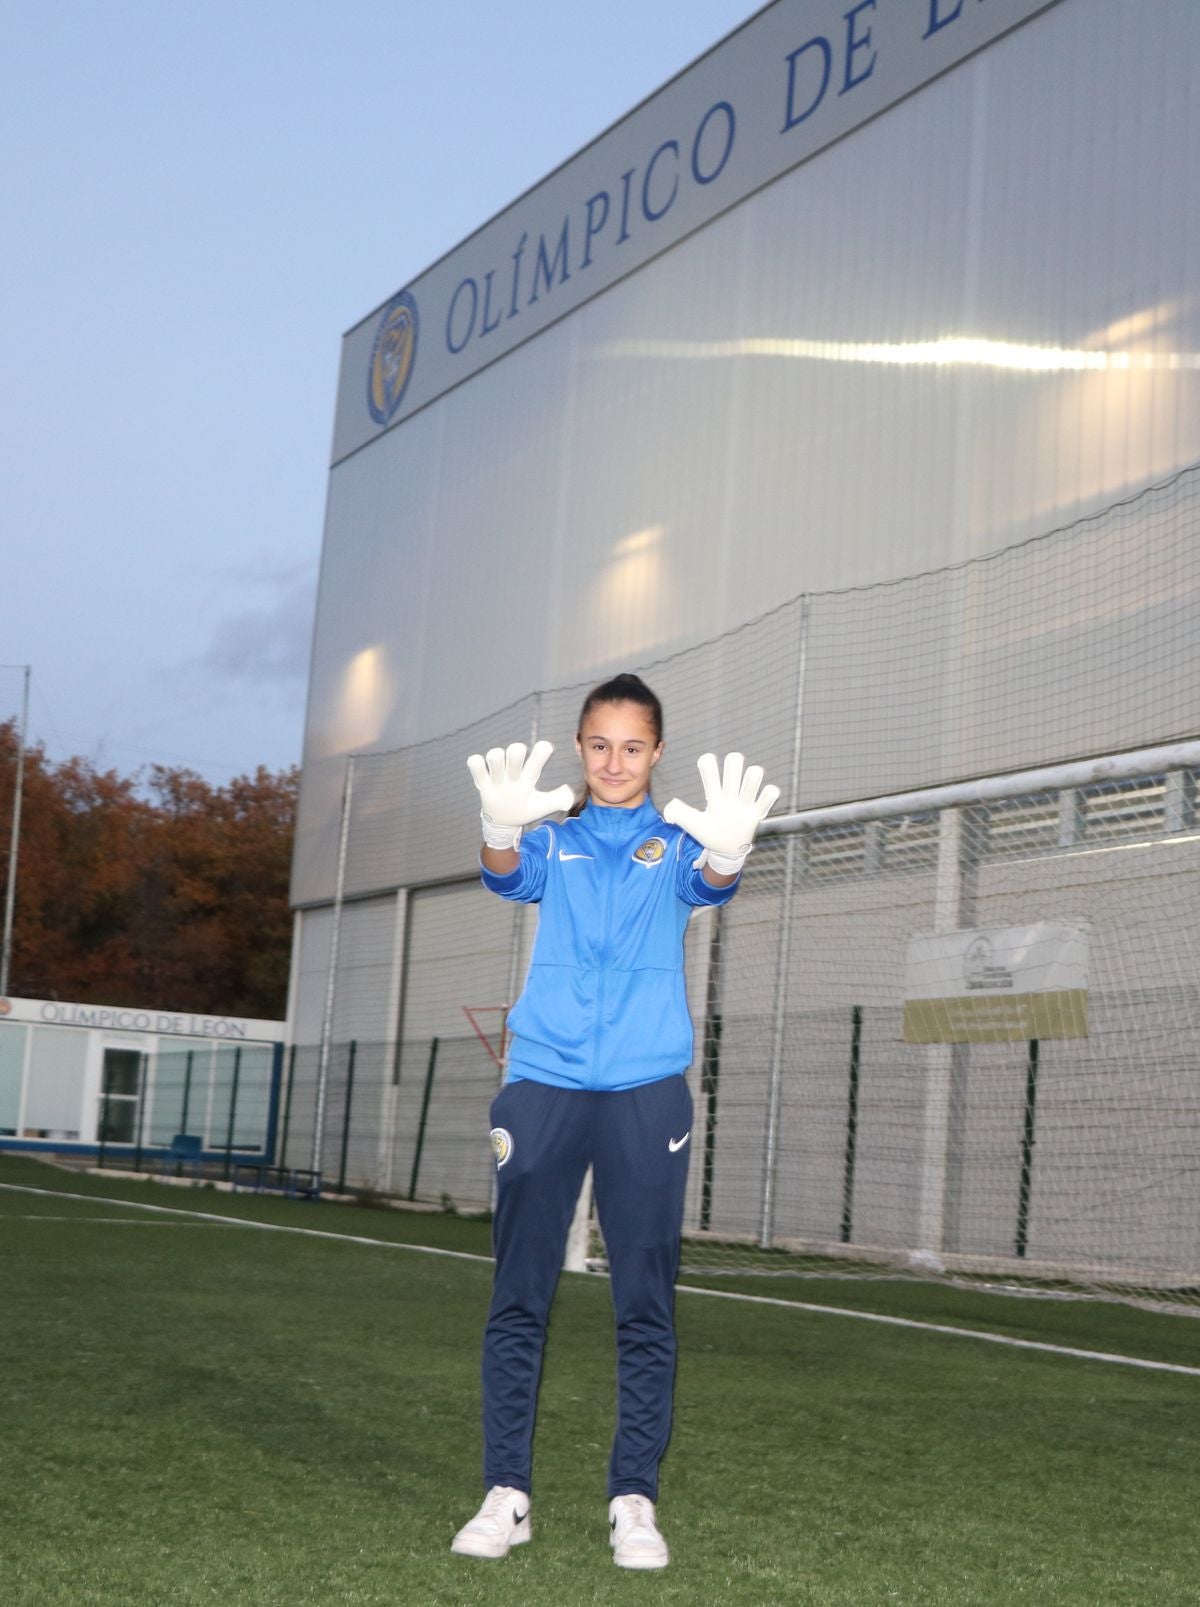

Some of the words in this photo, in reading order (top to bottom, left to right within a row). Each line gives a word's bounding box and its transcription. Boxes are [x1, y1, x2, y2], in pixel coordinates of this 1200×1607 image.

[445, 101, 736, 354] OLÍMPICO
[779, 0, 878, 134] DE
[156, 1015, 184, 1033] DE
